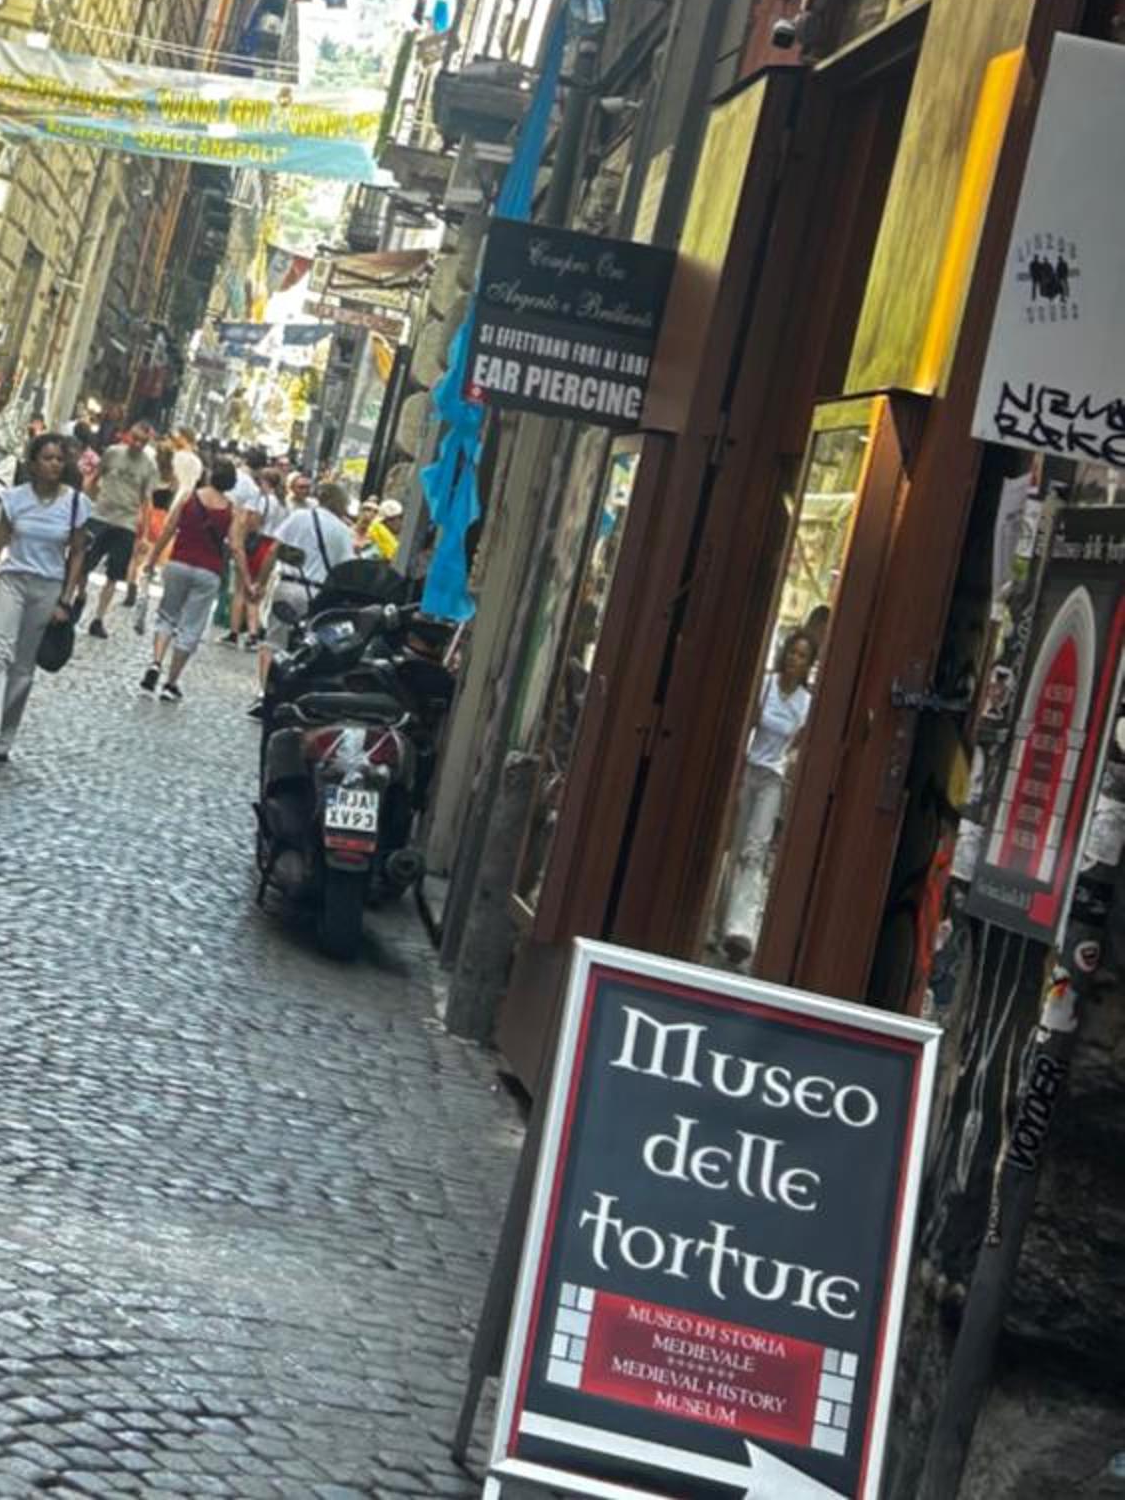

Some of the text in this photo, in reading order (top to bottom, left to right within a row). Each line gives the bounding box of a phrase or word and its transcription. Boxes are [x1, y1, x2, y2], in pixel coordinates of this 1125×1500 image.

[479, 323, 495, 345] SI
[496, 326, 571, 361] EFFETTUANO
[572, 340, 604, 368] FORI
[603, 349, 619, 371] AI
[472, 353, 644, 419] EAR PIERCING
[608, 1004, 880, 1129] Museo
[641, 1113, 822, 1212] delle
[578, 1190, 862, 1321] torture
[625, 1303, 787, 1360] MUSEO DI STORIA
[651, 1332, 756, 1373] MEDIEVALE
[609, 1354, 787, 1414] MEDIEVAL HISTORY
[652, 1389, 738, 1426] MUSEUM
